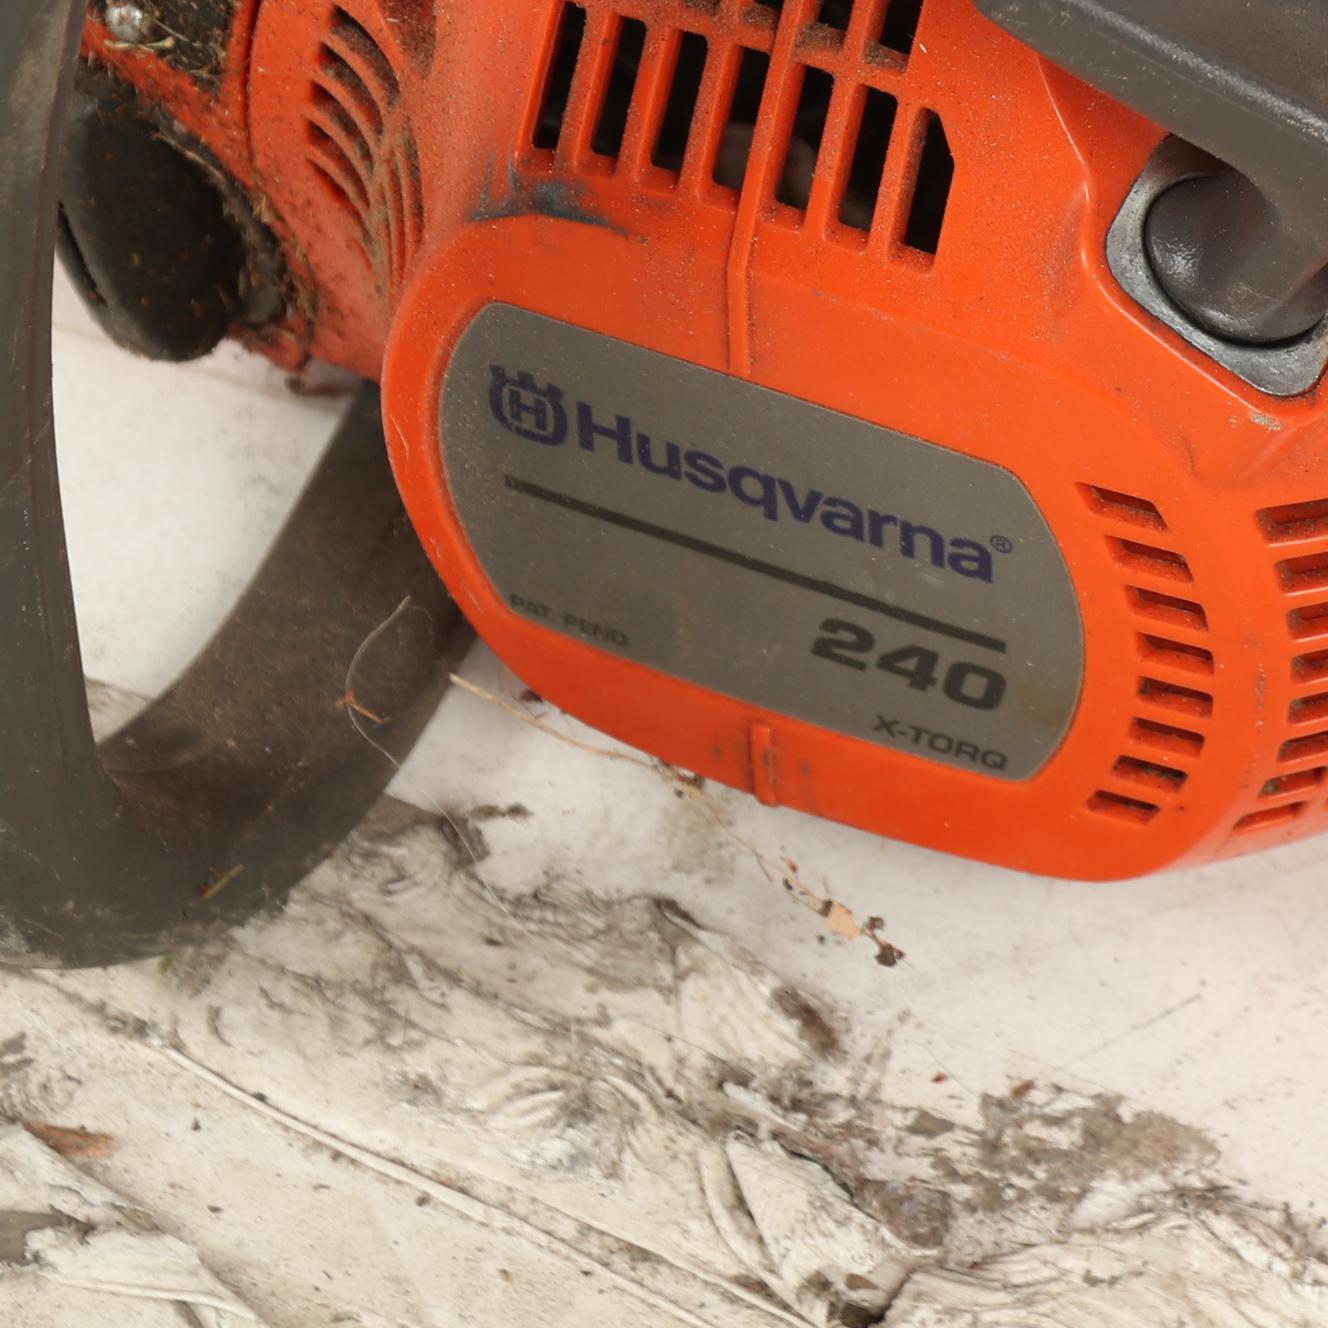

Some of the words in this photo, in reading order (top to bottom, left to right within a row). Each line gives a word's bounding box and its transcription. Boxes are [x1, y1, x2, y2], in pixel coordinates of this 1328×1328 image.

[563, 611, 628, 645] PEND
[811, 619, 1006, 710] 240
[872, 713, 1007, 770] X-TORQ
